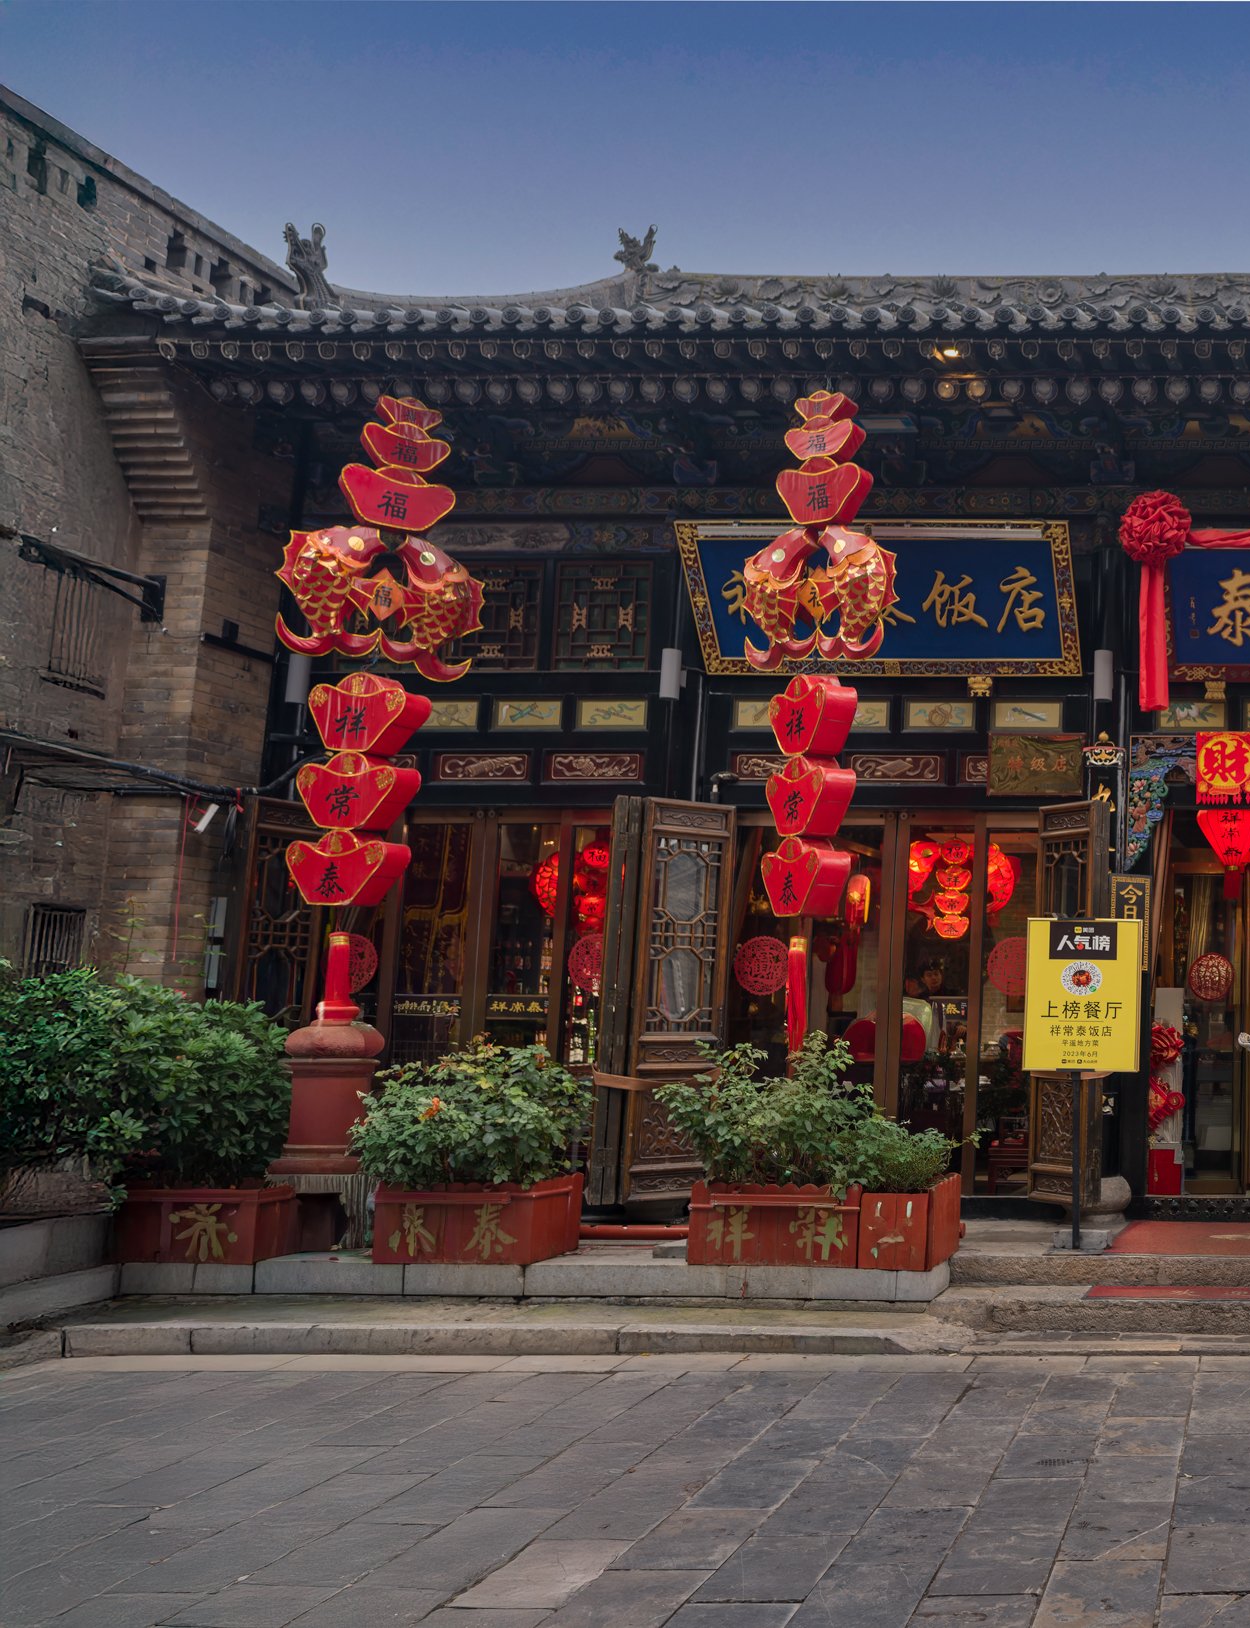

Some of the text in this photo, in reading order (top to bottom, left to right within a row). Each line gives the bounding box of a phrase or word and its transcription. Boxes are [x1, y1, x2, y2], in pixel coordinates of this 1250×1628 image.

[391, 443, 418, 464] 福
[806, 434, 827, 452] 福
[377, 491, 409, 520] 福
[806, 483, 829, 512] 福
[374, 585, 393, 609] 福
[313, 706, 368, 899] 祥 常 泰
[779, 707, 806, 907] 祥 常 泰
[1057, 935, 1111, 951] 人气榜
[1040, 1000, 1123, 1020] 上榜餐厅
[1050, 1025, 1113, 1037] 祥常泰饭店
[1062, 1050, 1098, 1058] 2023年6月
